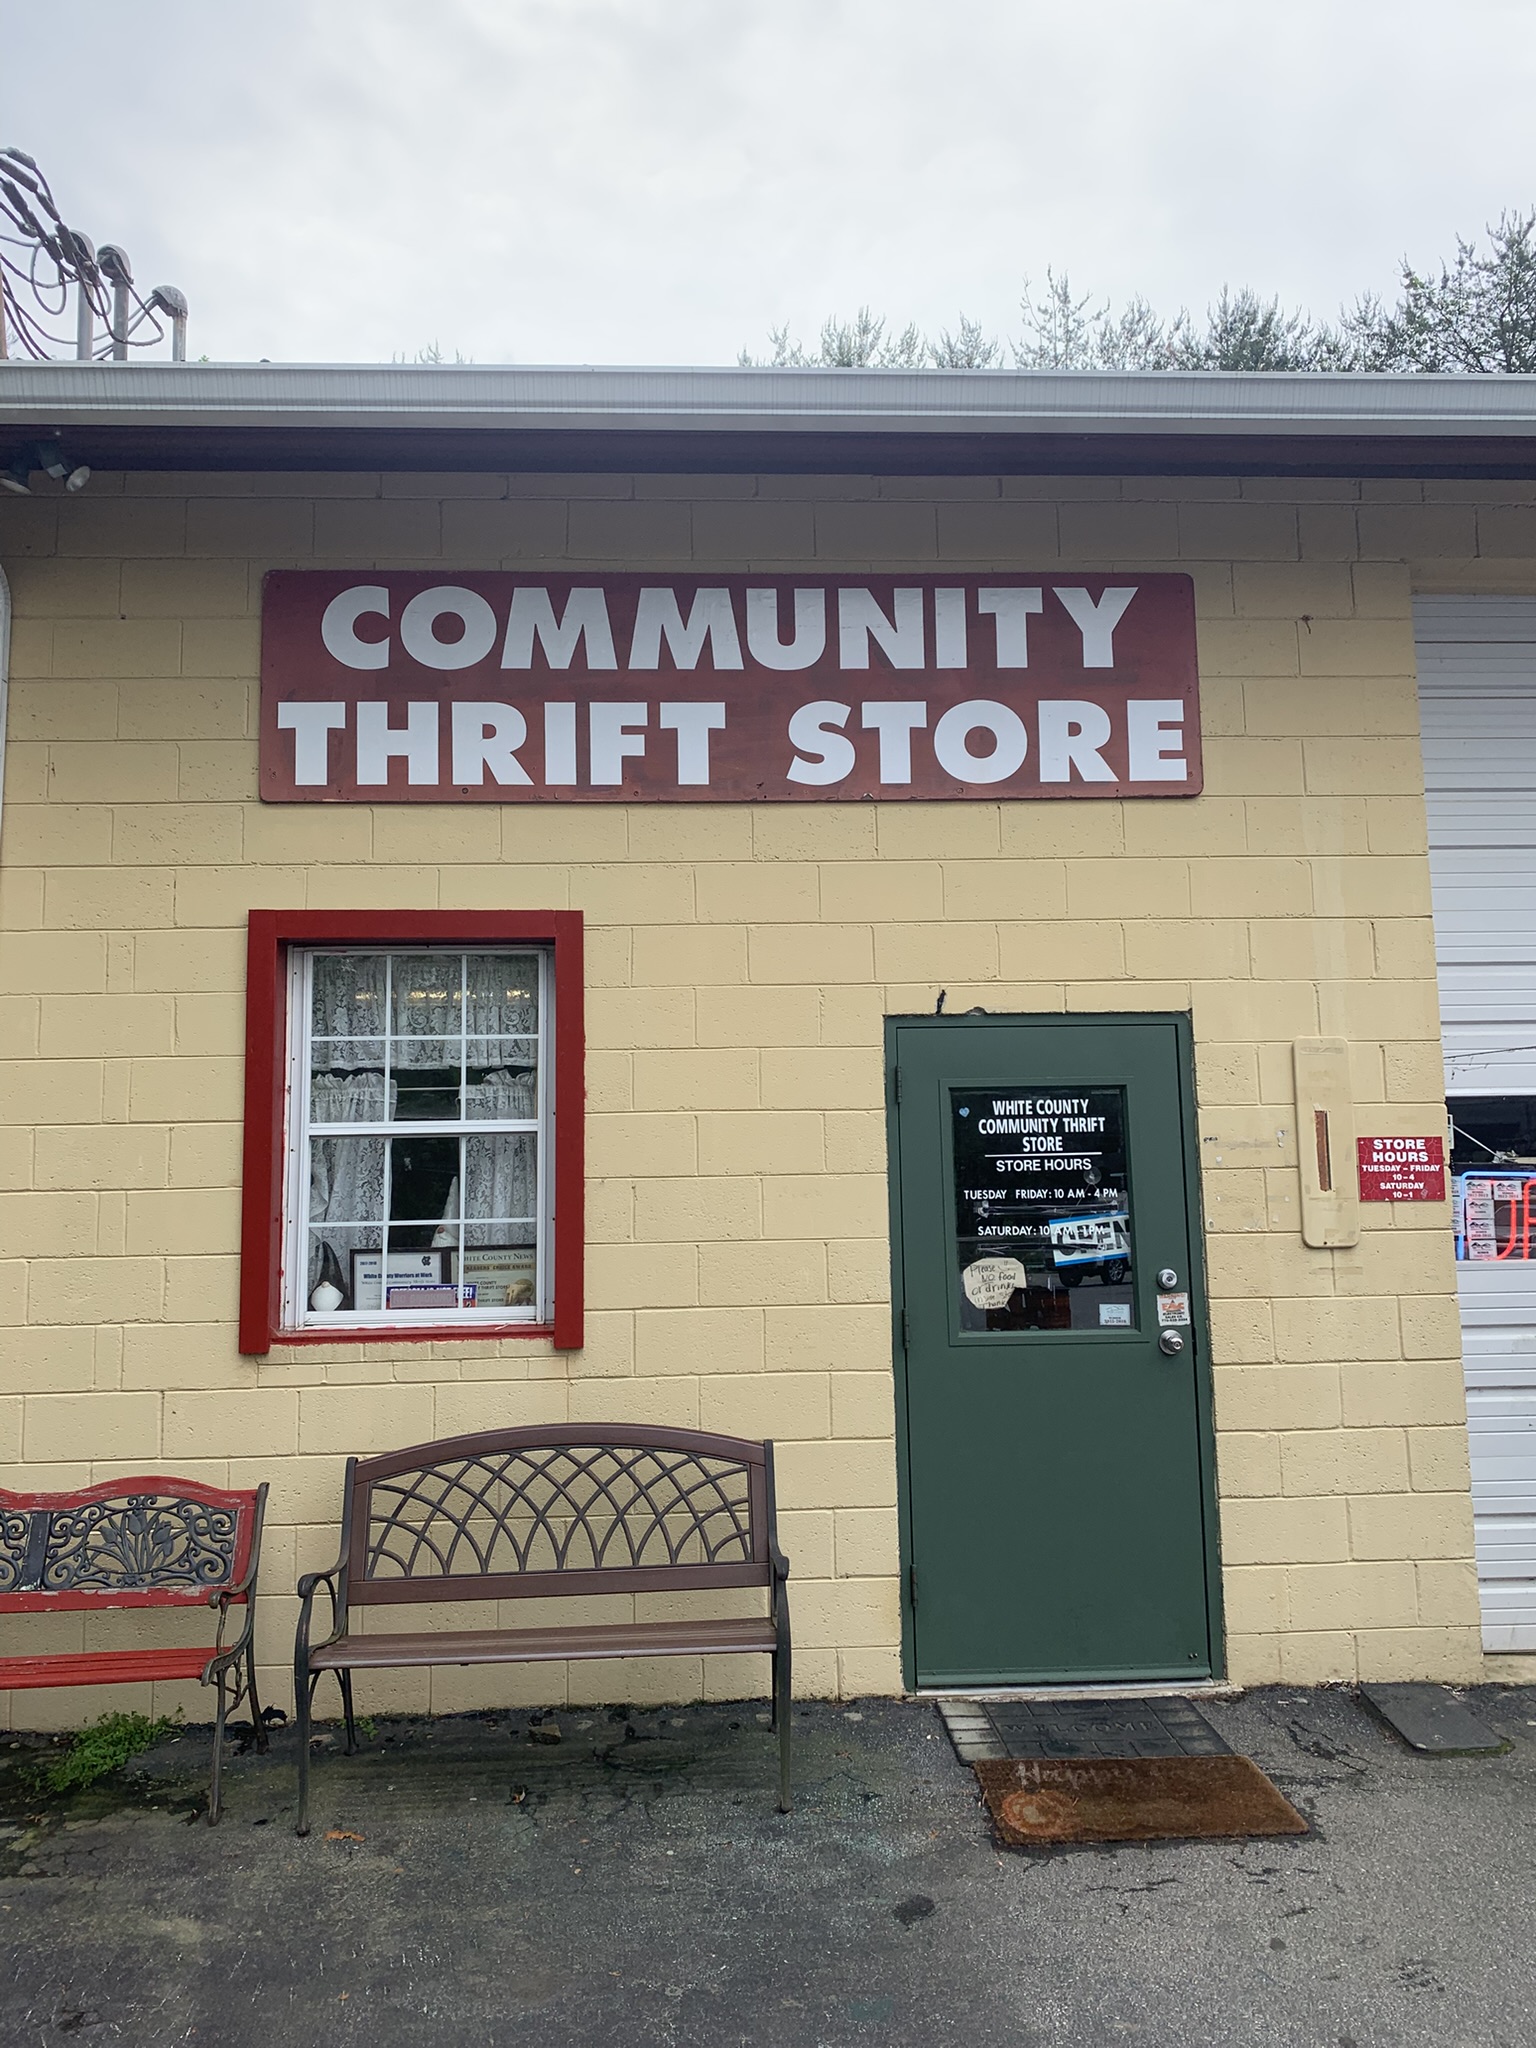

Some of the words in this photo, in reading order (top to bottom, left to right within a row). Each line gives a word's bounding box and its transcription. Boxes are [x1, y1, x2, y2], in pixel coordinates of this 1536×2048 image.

[320, 585, 1139, 672] COMMUNITY
[276, 700, 727, 788] THRIFT
[786, 698, 1188, 786] STORE
[992, 1100, 1033, 1116] WHITE
[1036, 1098, 1089, 1115] COUNTY
[978, 1118, 1059, 1134] COMMUNITY
[1062, 1117, 1106, 1132] THRIFT
[1022, 1136, 1064, 1152] STORE
[1373, 1138, 1426, 1150] STORE
[1372, 1151, 1429, 1163] HOURS
[996, 1159, 1042, 1172] STORE
[1044, 1158, 1092, 1171] HOURS
[1362, 1164, 1402, 1172] TUESDAY
[1410, 1164, 1441, 1172] FRIDAY
[1379, 1182, 1425, 1190] SATURDAY
[963, 1189, 1008, 1200] TUESDAY
[1015, 1188, 1052, 1199] FRIDAY:
[1053, 1188, 1065, 1199] 10
[1067, 1188, 1086, 1199] AM
[1093, 1188, 1101, 1198] 4
[1103, 1187, 1119, 1198] PM
[977, 1225, 1037, 1237] SATURDAY:
[1039, 1225, 1050, 1236] 10
[998, 1271, 1017, 1282] food
[1000, 1720, 1157, 1735] WELCOME
